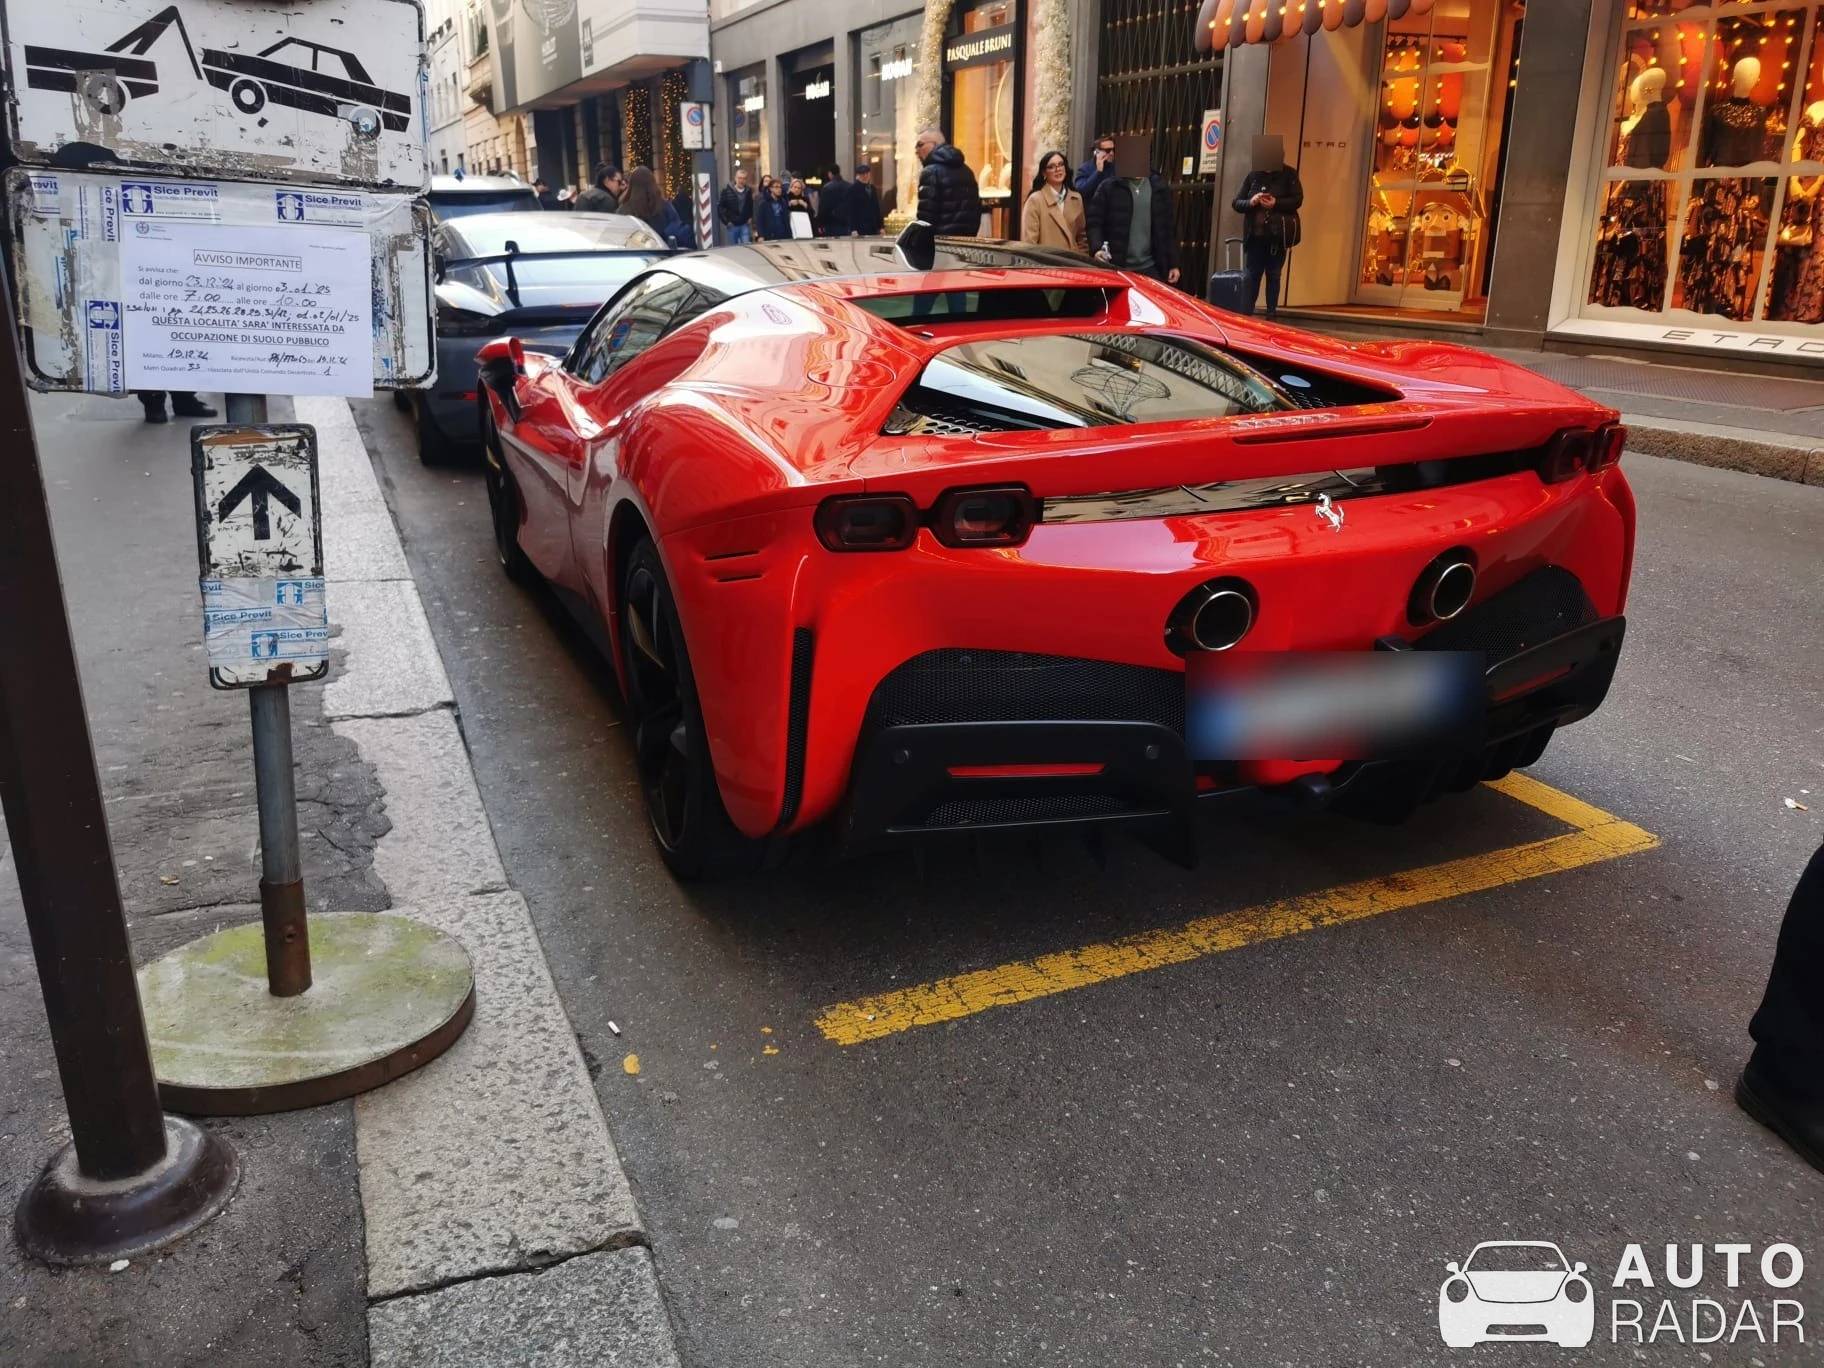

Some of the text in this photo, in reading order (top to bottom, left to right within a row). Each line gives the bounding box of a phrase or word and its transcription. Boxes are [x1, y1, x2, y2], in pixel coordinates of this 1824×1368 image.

[946, 32, 1012, 61] PASQUALE BRUNI
[1303, 140, 1347, 149] ETRO
[153, 185, 219, 198] Sice Previt
[304, 194, 362, 207] Sice Previt
[106, 207, 116, 243] Previt
[194, 253, 301, 270] AVVISO IMPORTANTE
[138, 277, 153, 286] dal
[154, 278, 184, 288] giorno
[236, 282, 245, 291] al
[246, 283, 273, 293] giorno
[139, 291, 161, 301] dalle
[163, 293, 178, 301] ore
[236, 296, 251, 306] alle
[252, 297, 268, 306] ore
[151, 315, 345, 333] QUESTA LOCALITA' SARA' INTERESSATA DA
[111, 331, 120, 357] Sice
[170, 331, 238, 342] OCCUPAZIONE
[253, 335, 284, 344] SUOLO
[286, 337, 330, 346] PUBBLICO
[1662, 329, 1824, 354] ETRO
[211, 610, 272, 622] Sice Previt
[279, 630, 328, 639] Sice Prev
